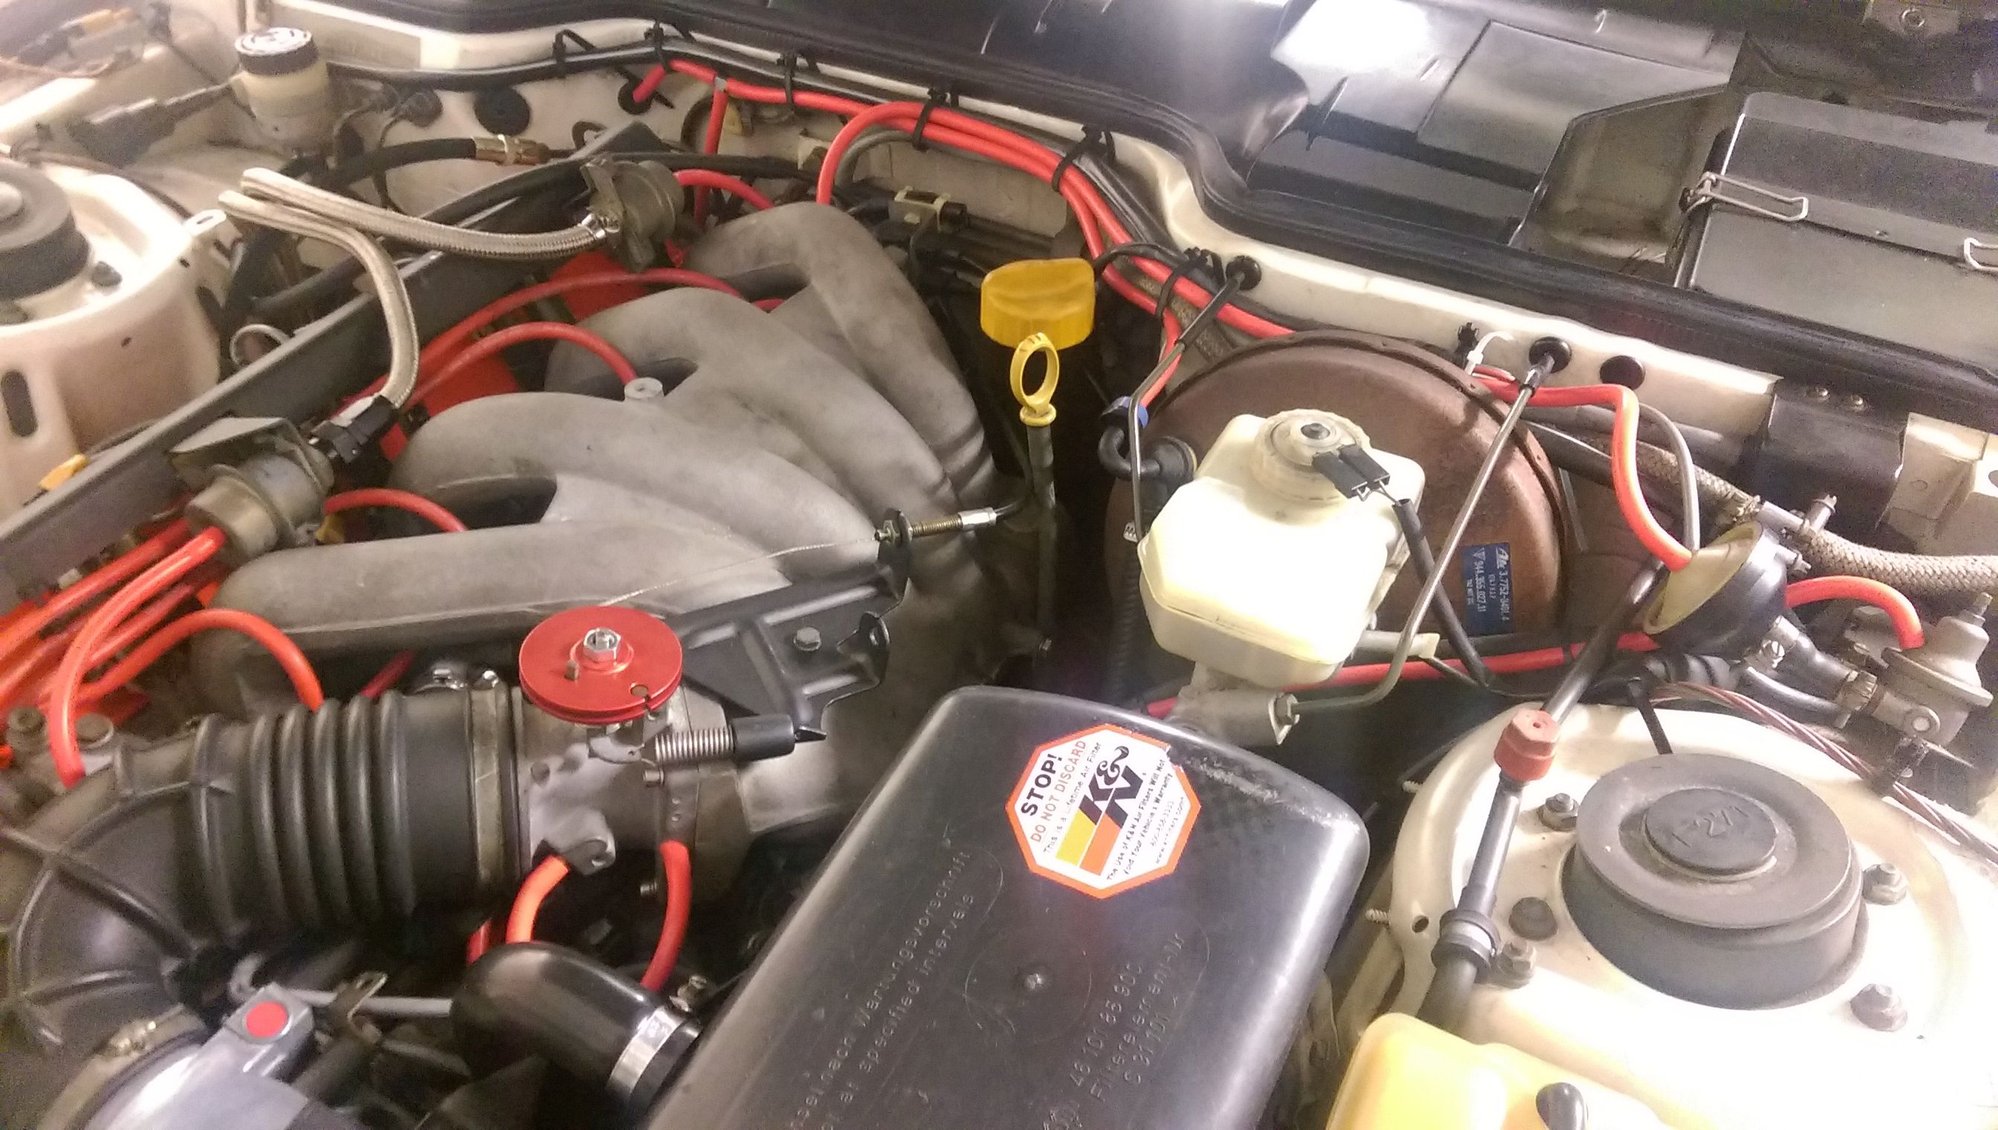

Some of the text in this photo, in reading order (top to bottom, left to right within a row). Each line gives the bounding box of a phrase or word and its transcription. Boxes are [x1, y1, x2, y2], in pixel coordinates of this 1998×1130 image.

[1021, 753, 1063, 816] STOP!
[1030, 740, 1087, 843] DO NOT DISCARD
[1043, 835, 1057, 853] This
[1065, 780, 1084, 812] Lfetime
[1079, 764, 1090, 778] Air
[1086, 741, 1102, 763] Filter
[1078, 745, 1144, 830] K&N
